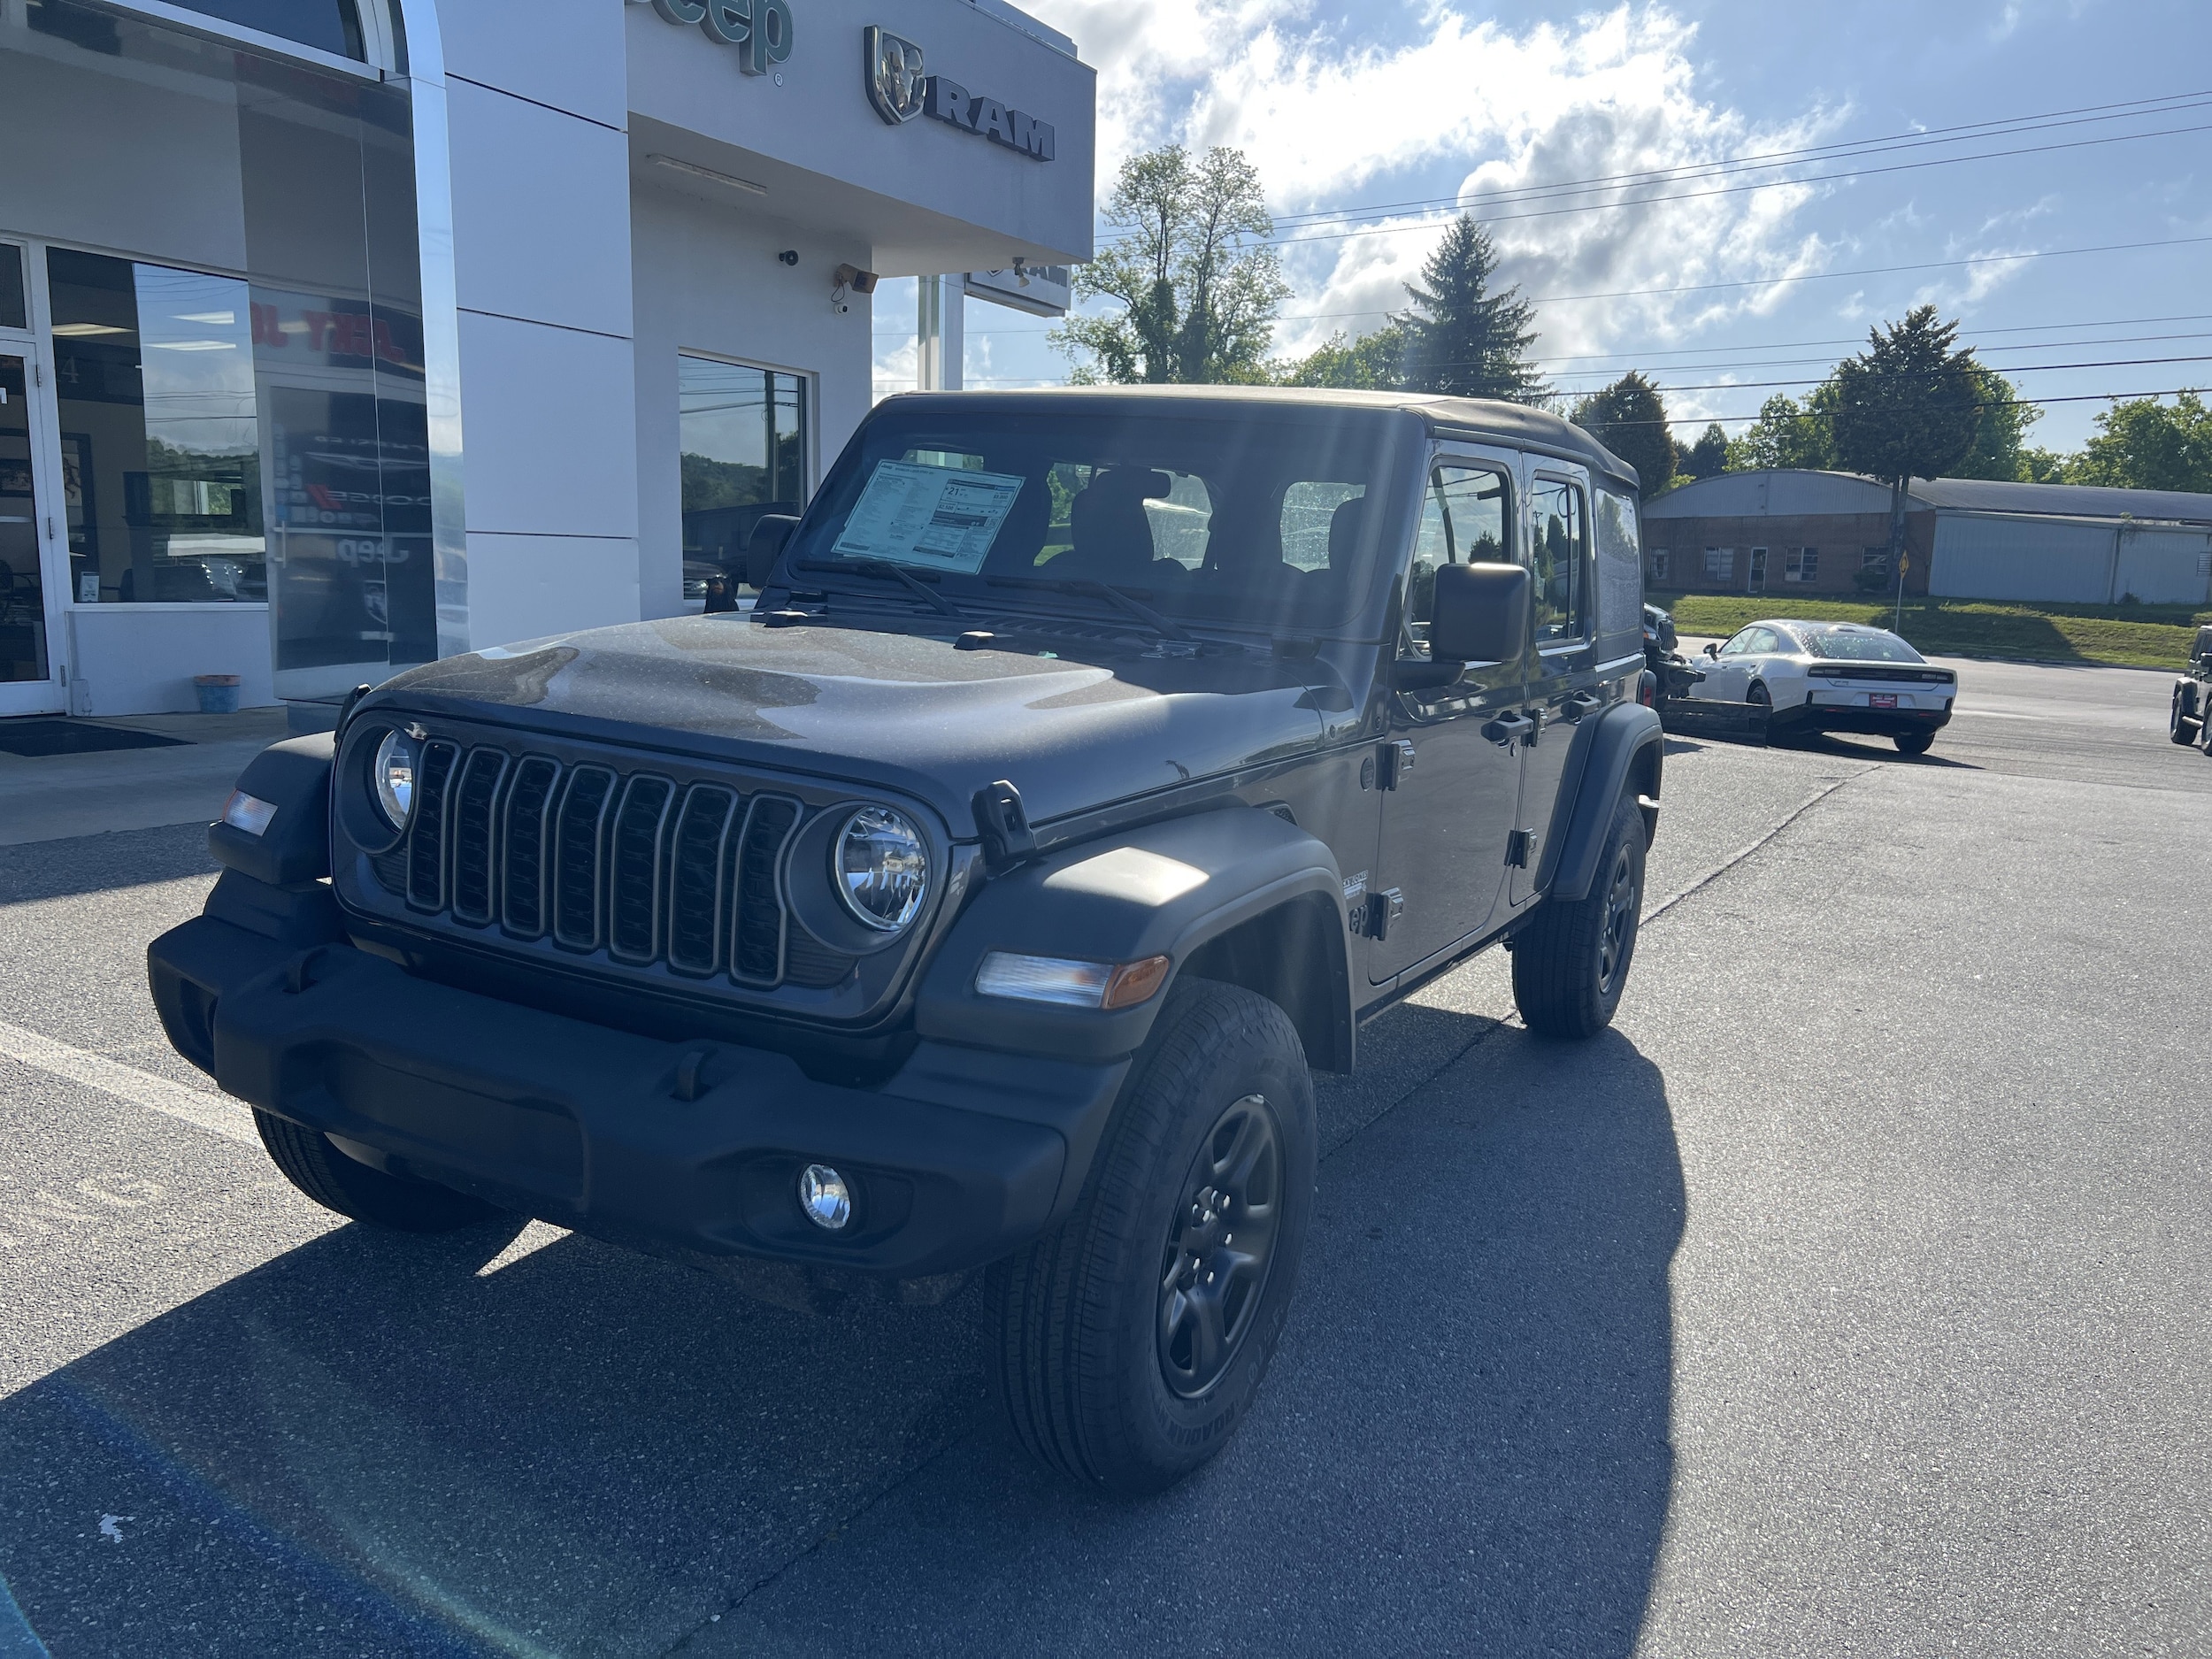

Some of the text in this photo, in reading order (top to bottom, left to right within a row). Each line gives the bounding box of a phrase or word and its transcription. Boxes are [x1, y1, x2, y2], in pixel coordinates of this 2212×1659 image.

[625, 0, 794, 76] ep
[925, 75, 1056, 162] RAM
[1021, 265, 1068, 288] AM
[948, 487, 959, 496] 21
[1349, 904, 1370, 937] ep
